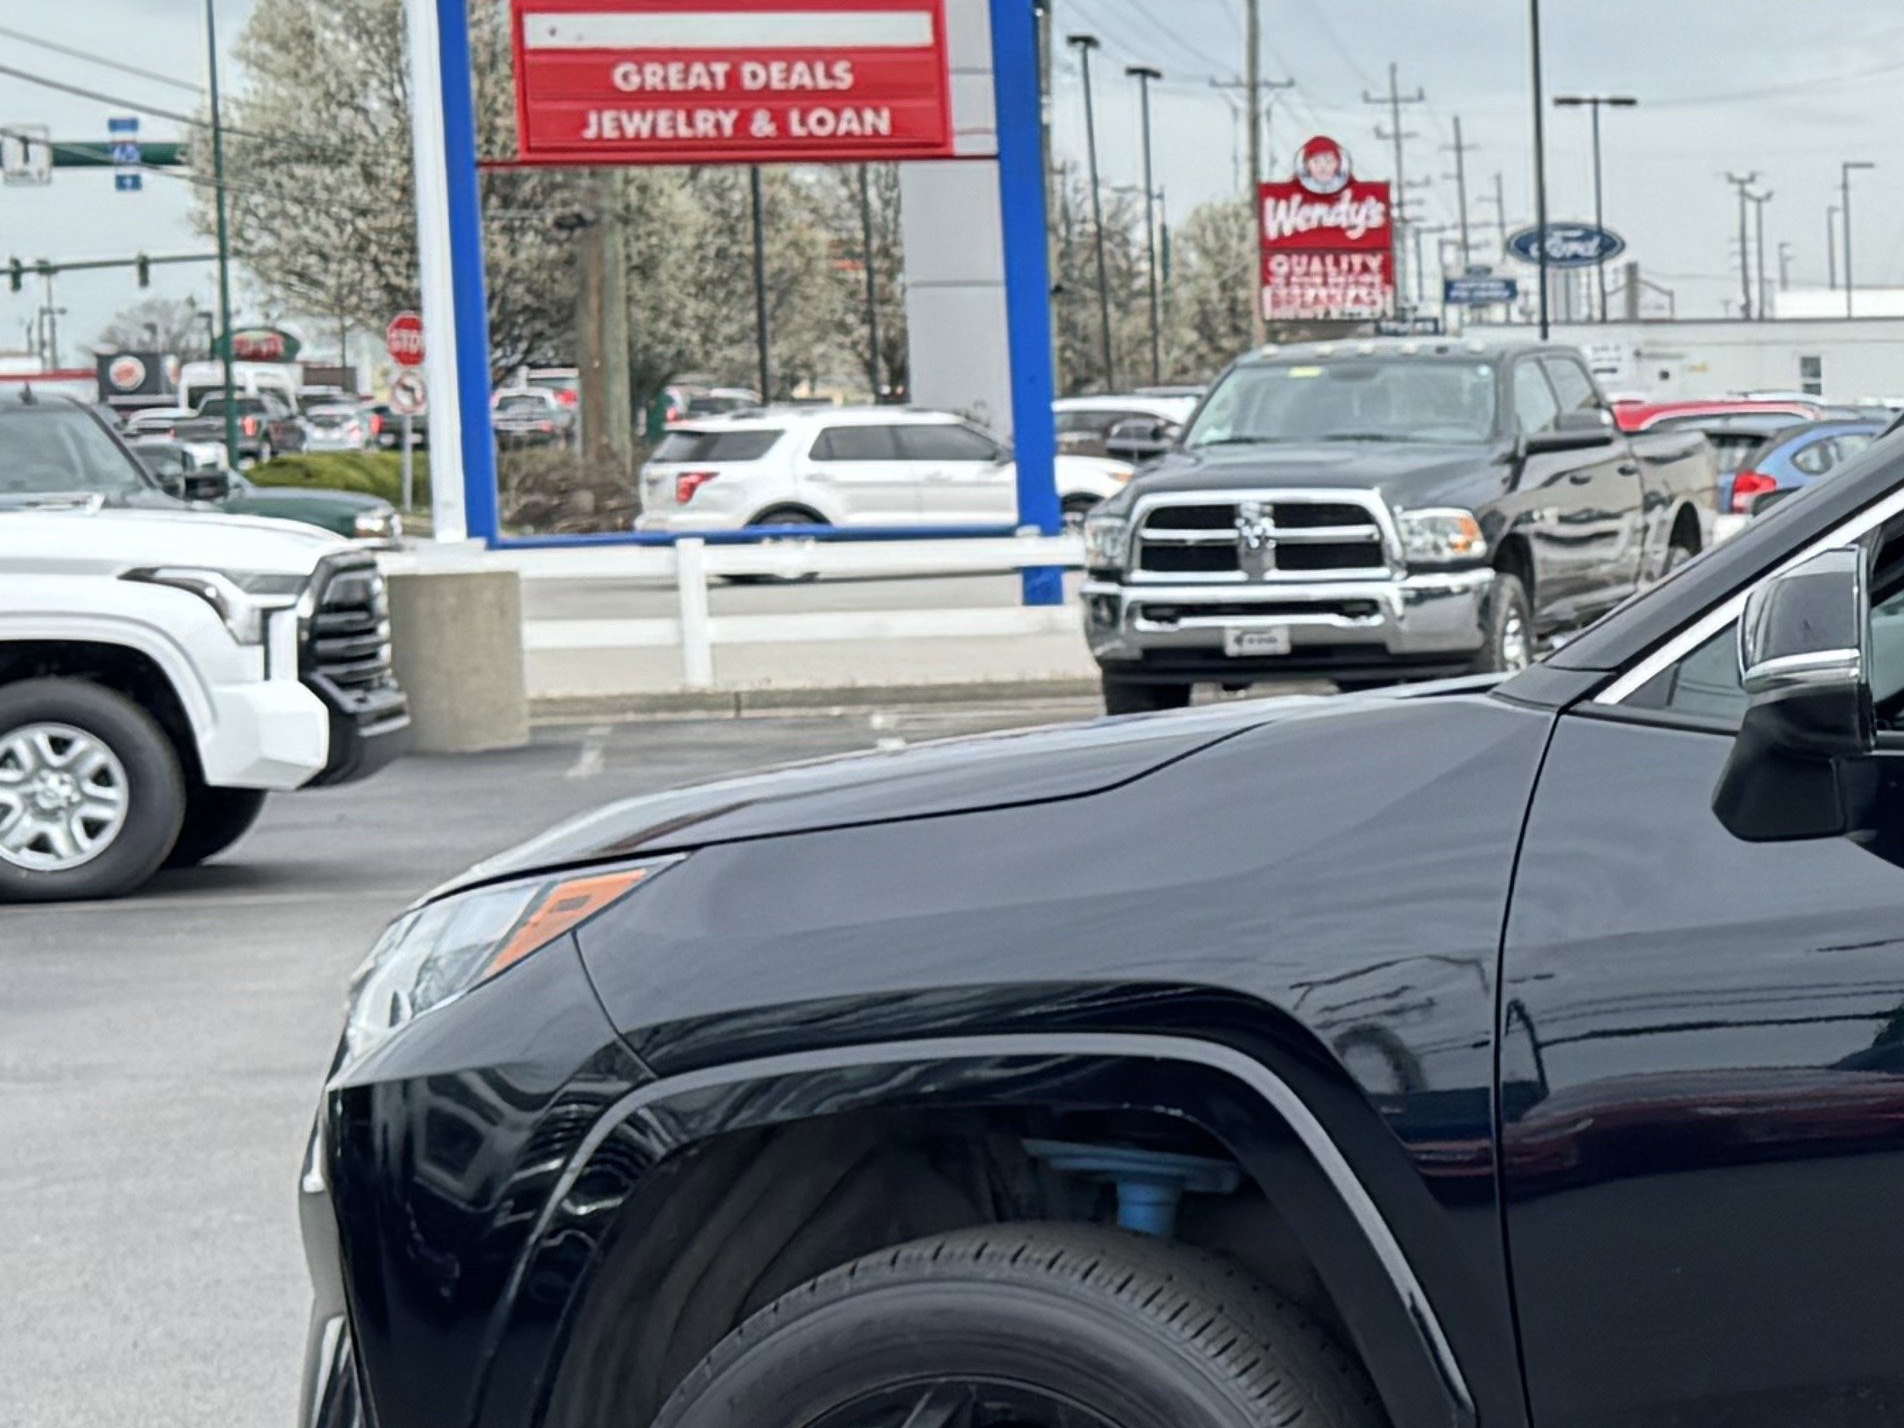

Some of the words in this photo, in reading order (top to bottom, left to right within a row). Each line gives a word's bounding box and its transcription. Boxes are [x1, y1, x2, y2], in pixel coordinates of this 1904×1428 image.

[612, 61, 731, 92] GREAT
[741, 60, 854, 91] DEALS
[582, 108, 739, 139] JEWELRY
[750, 108, 778, 137] &
[788, 106, 891, 137] LOAN
[1264, 188, 1385, 241] Wendy's
[1528, 229, 1601, 259] Ford
[1268, 254, 1383, 276] QUALITY
